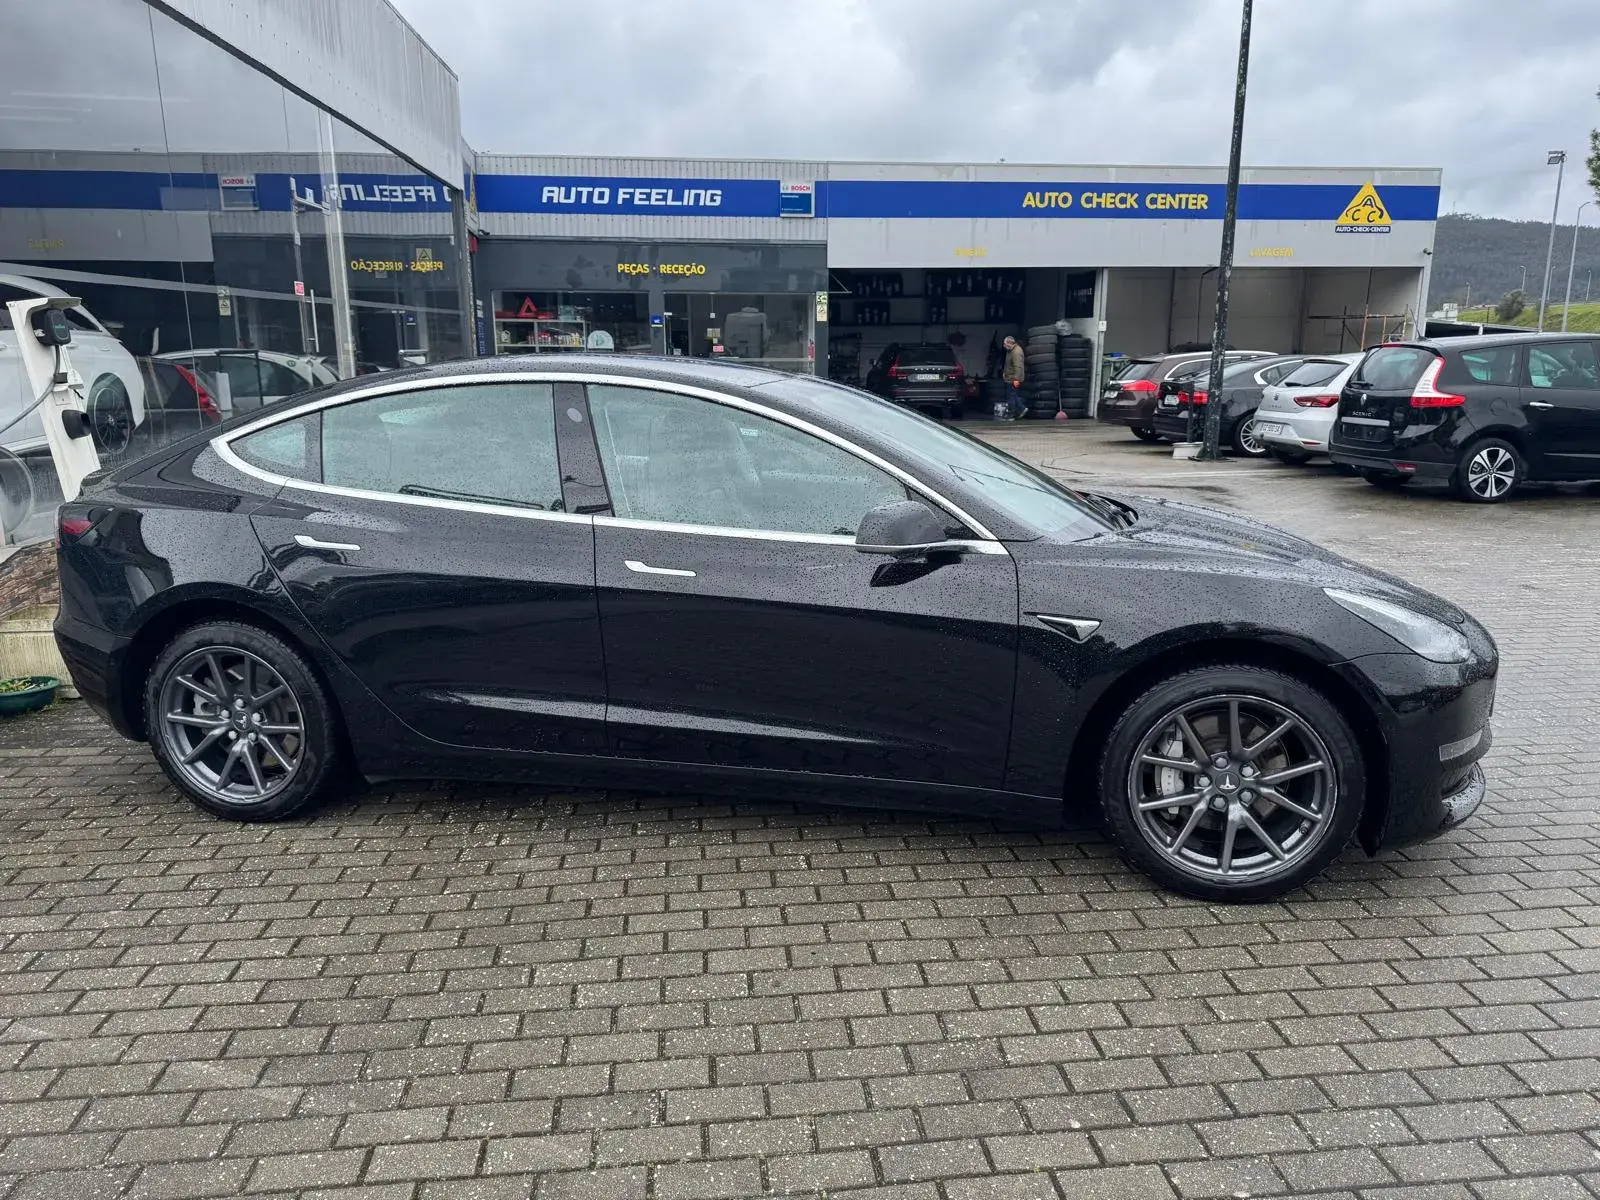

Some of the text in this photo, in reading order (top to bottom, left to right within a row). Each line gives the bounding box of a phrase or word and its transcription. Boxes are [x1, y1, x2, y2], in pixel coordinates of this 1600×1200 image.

[541, 186, 723, 206] AUTO FEELING
[1022, 191, 1209, 210] AUTO CHECK CENTER
[617, 262, 706, 276] PEÇAS RECEÇÃO
